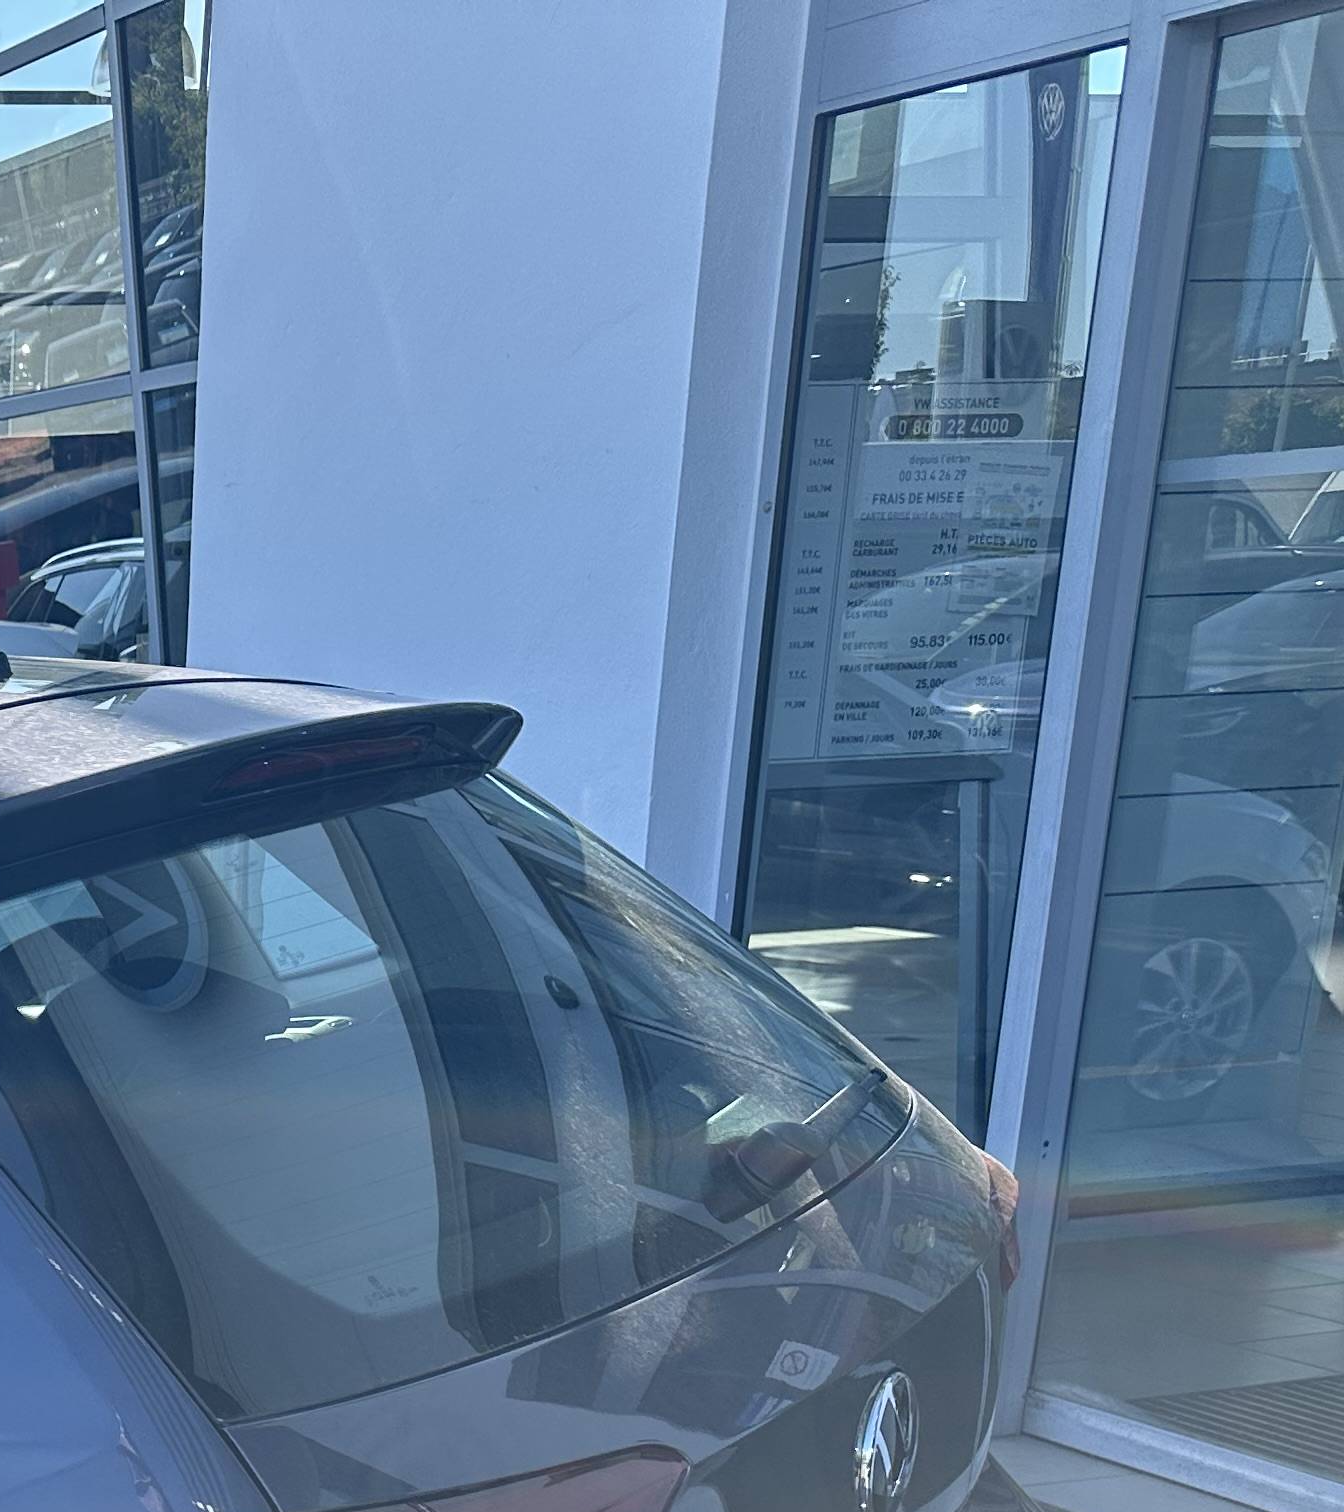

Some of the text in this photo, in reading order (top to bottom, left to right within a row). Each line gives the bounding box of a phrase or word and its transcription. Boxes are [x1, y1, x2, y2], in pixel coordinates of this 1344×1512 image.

[935, 397, 1000, 409] ASSISTANCE
[913, 418, 941, 434] 800
[947, 418, 965, 434] 22
[971, 417, 1009, 434] 4000
[872, 493, 905, 505] FRAIS
[908, 493, 923, 504] DE
[926, 492, 952, 504] MISE
[968, 533, 1038, 548] PIÈCES AUTO
